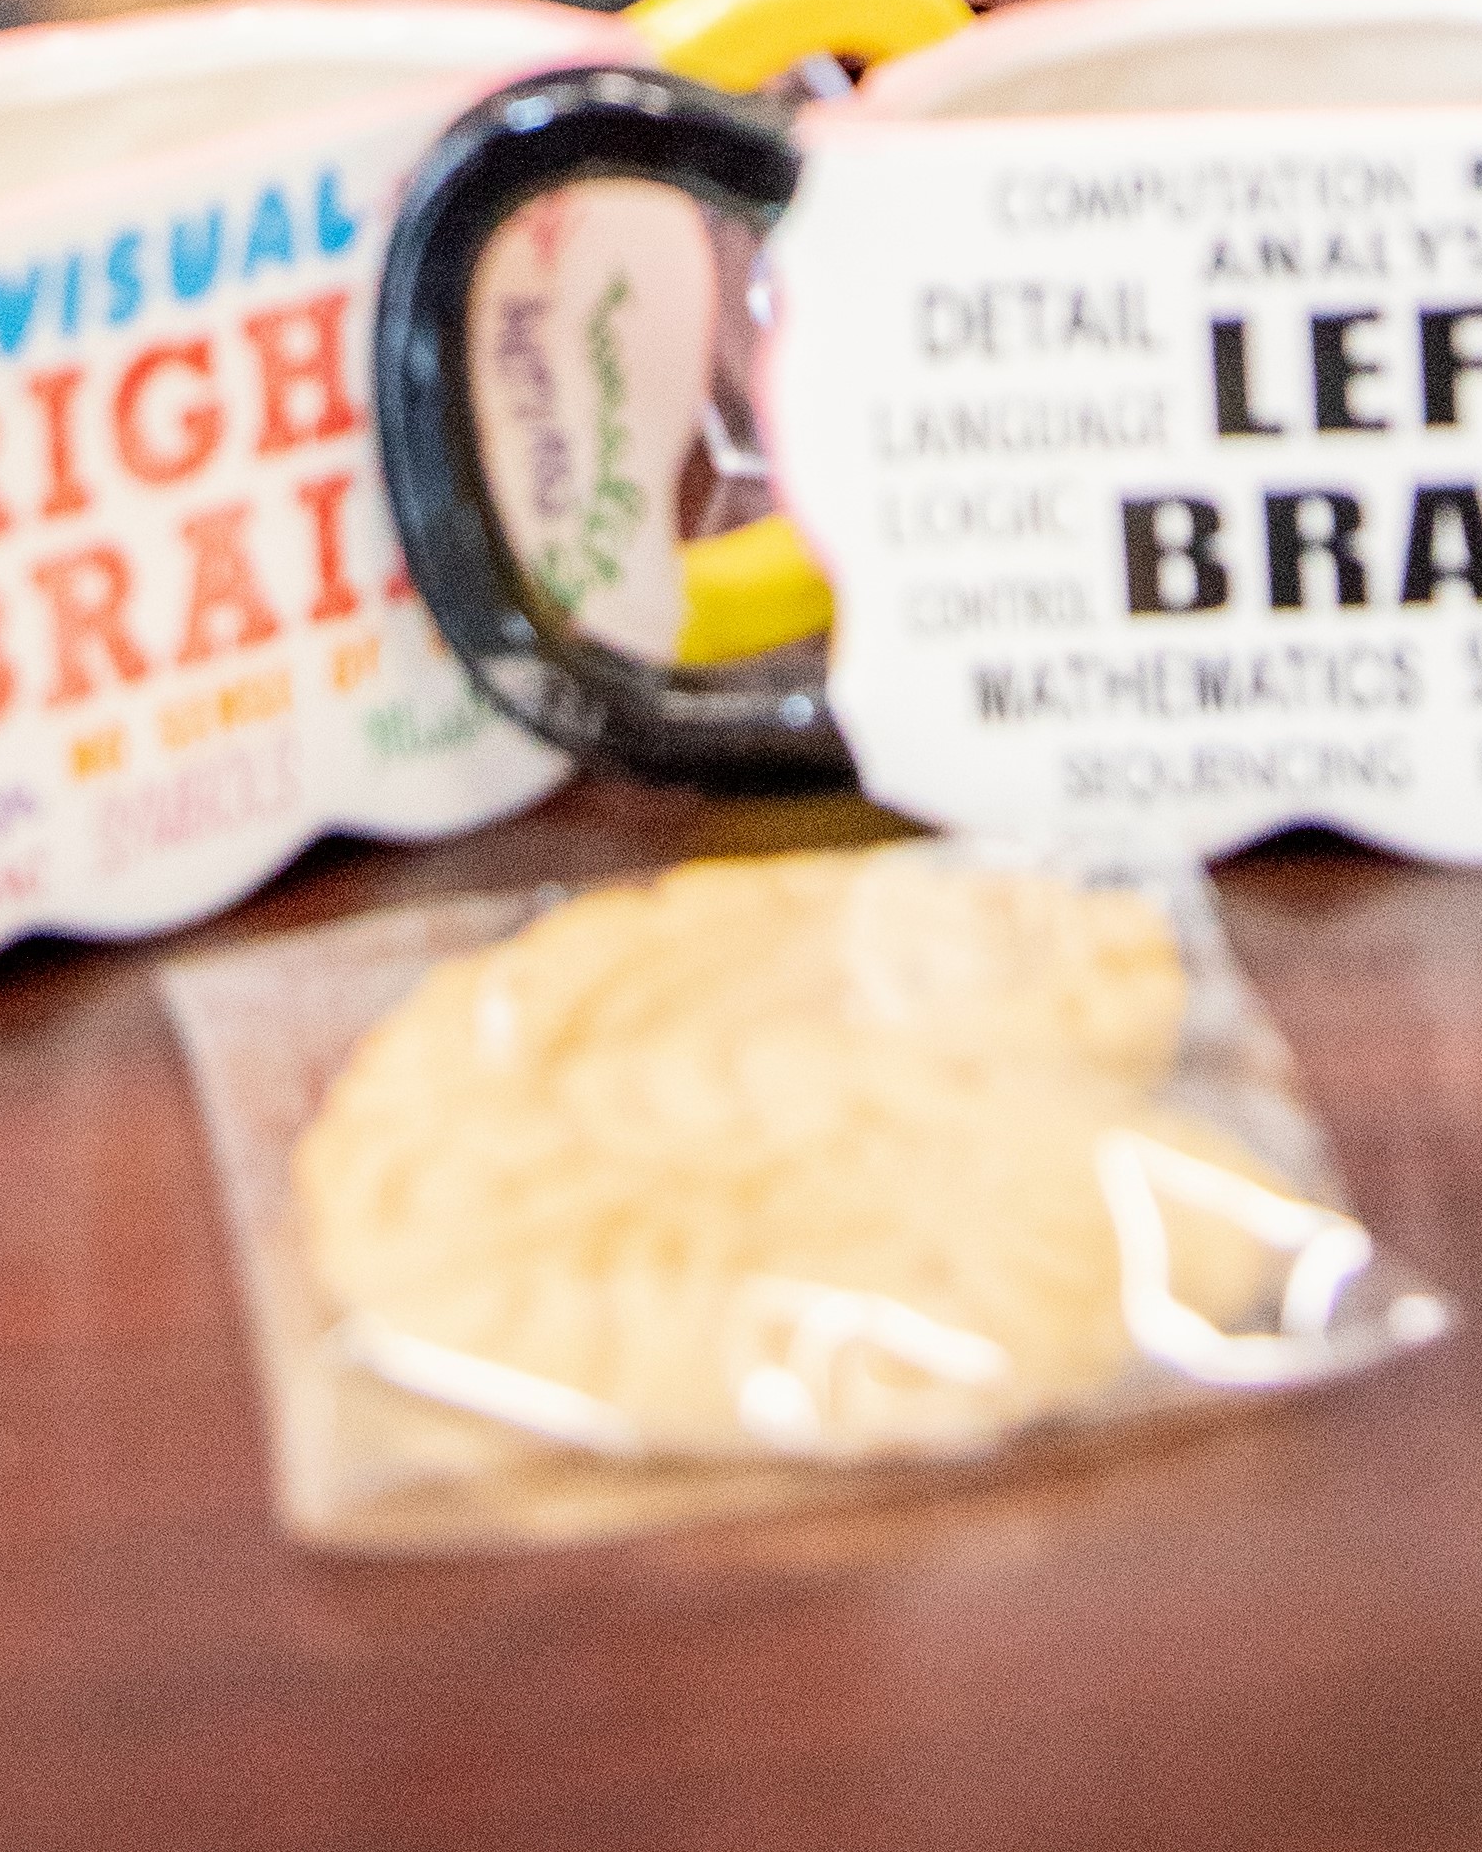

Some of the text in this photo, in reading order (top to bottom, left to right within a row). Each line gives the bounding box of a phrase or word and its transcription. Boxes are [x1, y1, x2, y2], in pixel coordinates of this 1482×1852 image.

[994, 155, 1417, 230] COMPUTATION
[918, 285, 1161, 361] DETAIL
[874, 387, 1169, 462] LANGUAGE
[880, 481, 1074, 547] LOGIC
[972, 640, 1421, 723] MATHEMATICS
[1059, 733, 1415, 803] SEQUENCING
